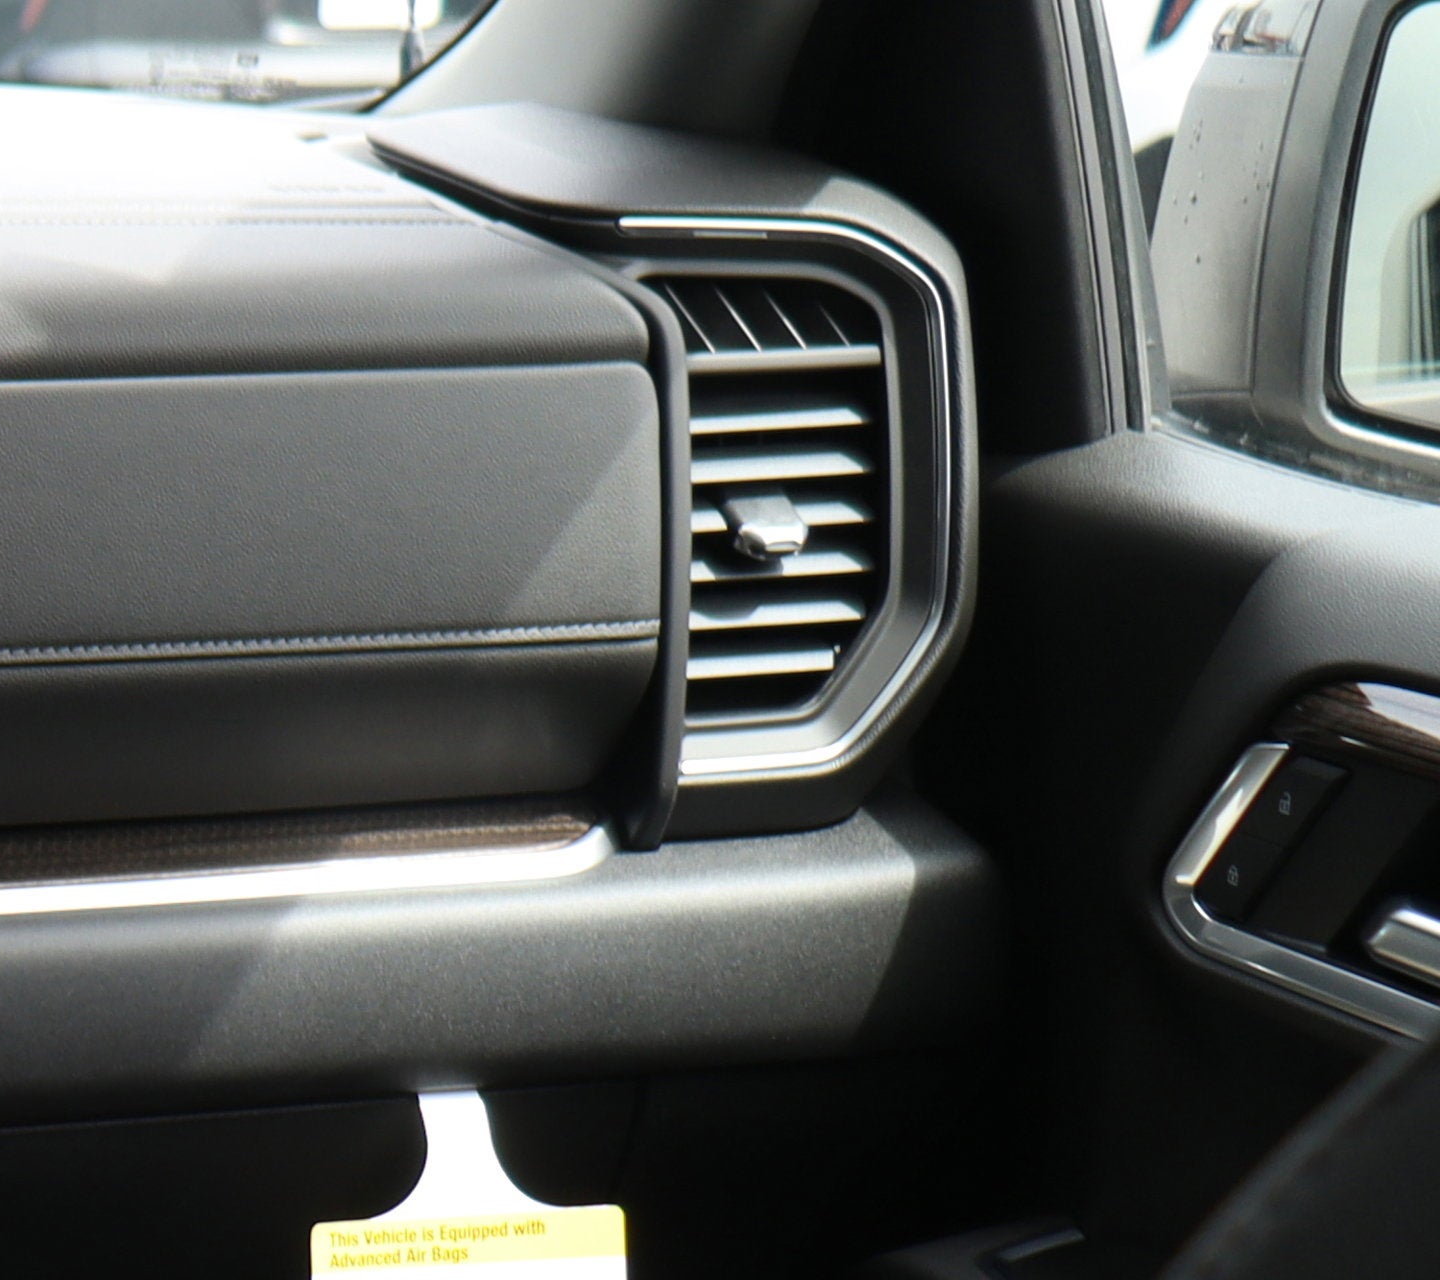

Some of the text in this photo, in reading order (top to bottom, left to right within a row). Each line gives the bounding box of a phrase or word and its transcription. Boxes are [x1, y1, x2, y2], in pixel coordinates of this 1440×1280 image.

[329, 1219, 546, 1248] This Vehicle is Equipped with
[329, 1245, 469, 1268] Advanced Air Bags
